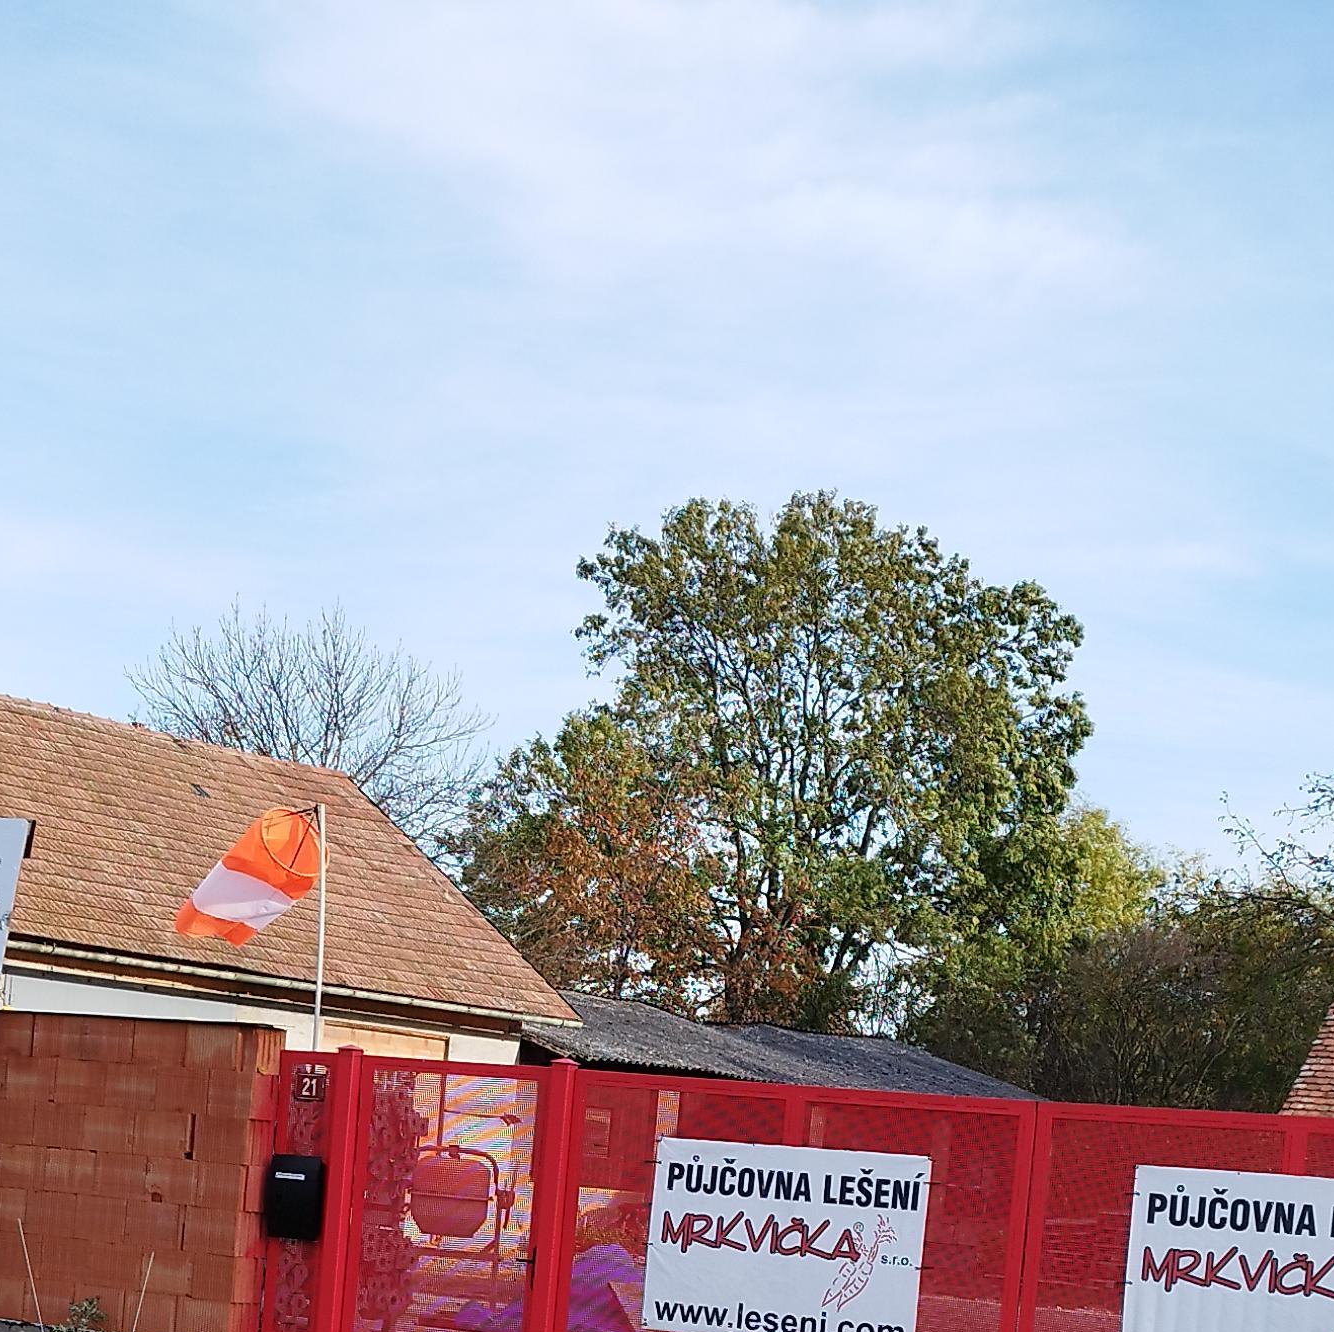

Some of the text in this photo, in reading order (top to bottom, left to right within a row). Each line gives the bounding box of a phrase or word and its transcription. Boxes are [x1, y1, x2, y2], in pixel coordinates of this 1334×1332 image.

[301, 1077, 317, 1096] 21
[667, 1155, 926, 1211] PŮJČOVNA LEŠENÍ
[1147, 1184, 1317, 1237] PŮJČOVNA
[880, 1253, 913, 1267] s.r.o.
